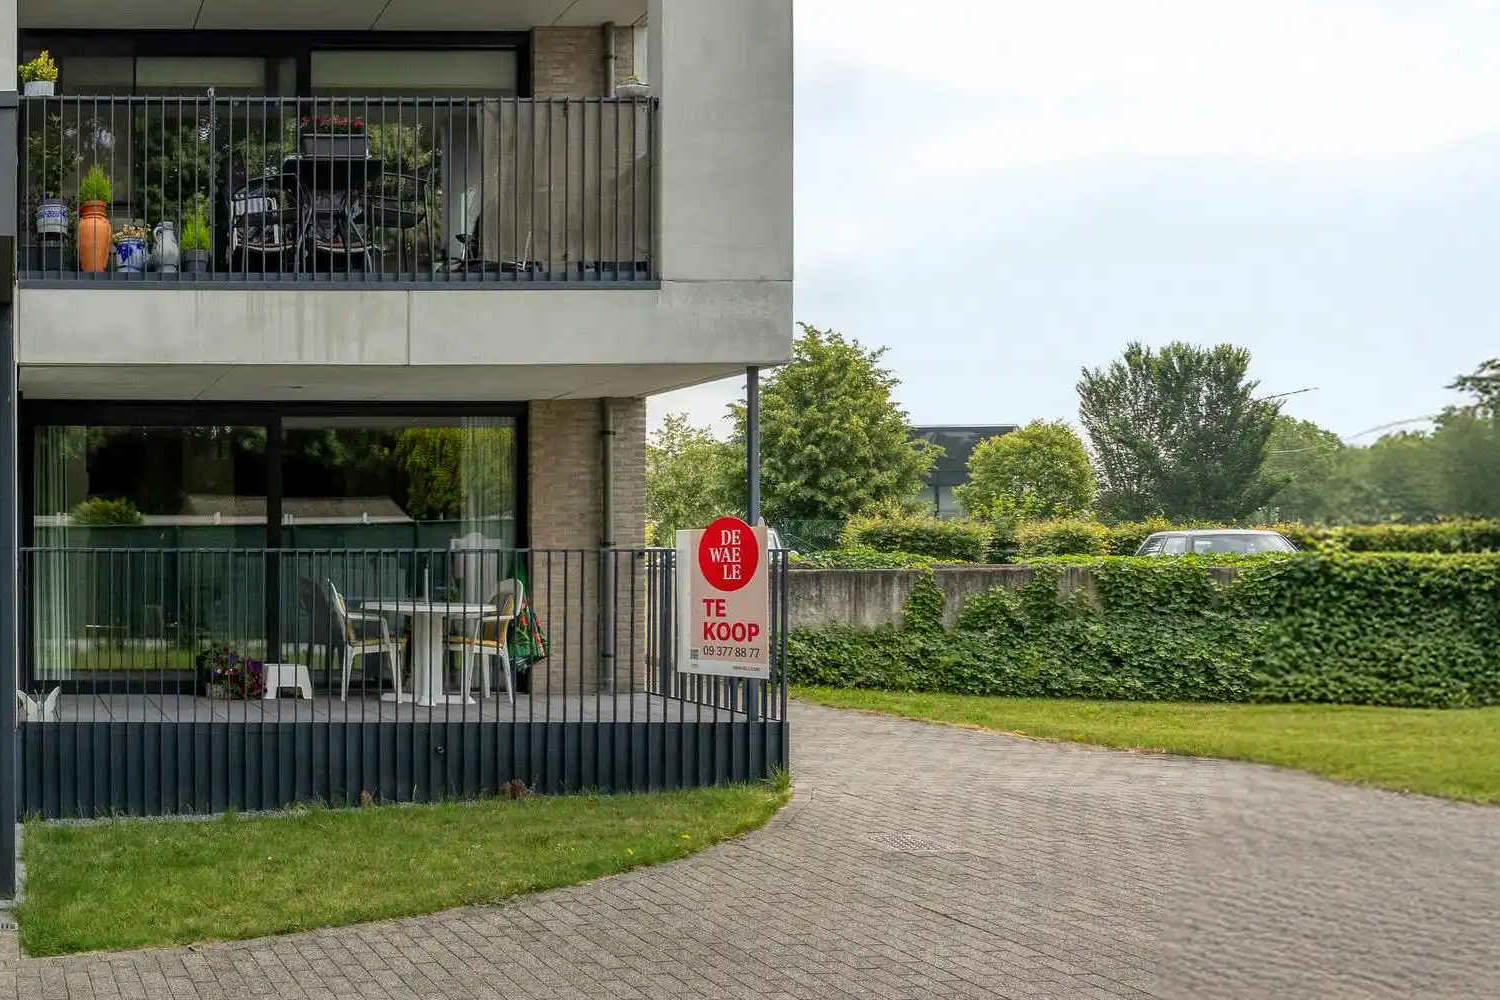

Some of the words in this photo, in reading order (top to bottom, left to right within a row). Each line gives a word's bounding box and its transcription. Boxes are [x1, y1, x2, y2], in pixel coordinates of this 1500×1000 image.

[720, 529, 741, 546] DE
[708, 547, 741, 563] WAE
[723, 564, 741, 580] LE
[702, 598, 726, 617] TE
[703, 621, 760, 642] KOOP
[703, 645, 715, 656] 09
[716, 646, 733, 656] 377
[734, 647, 747, 658] 88
[749, 647, 760, 659] 77
